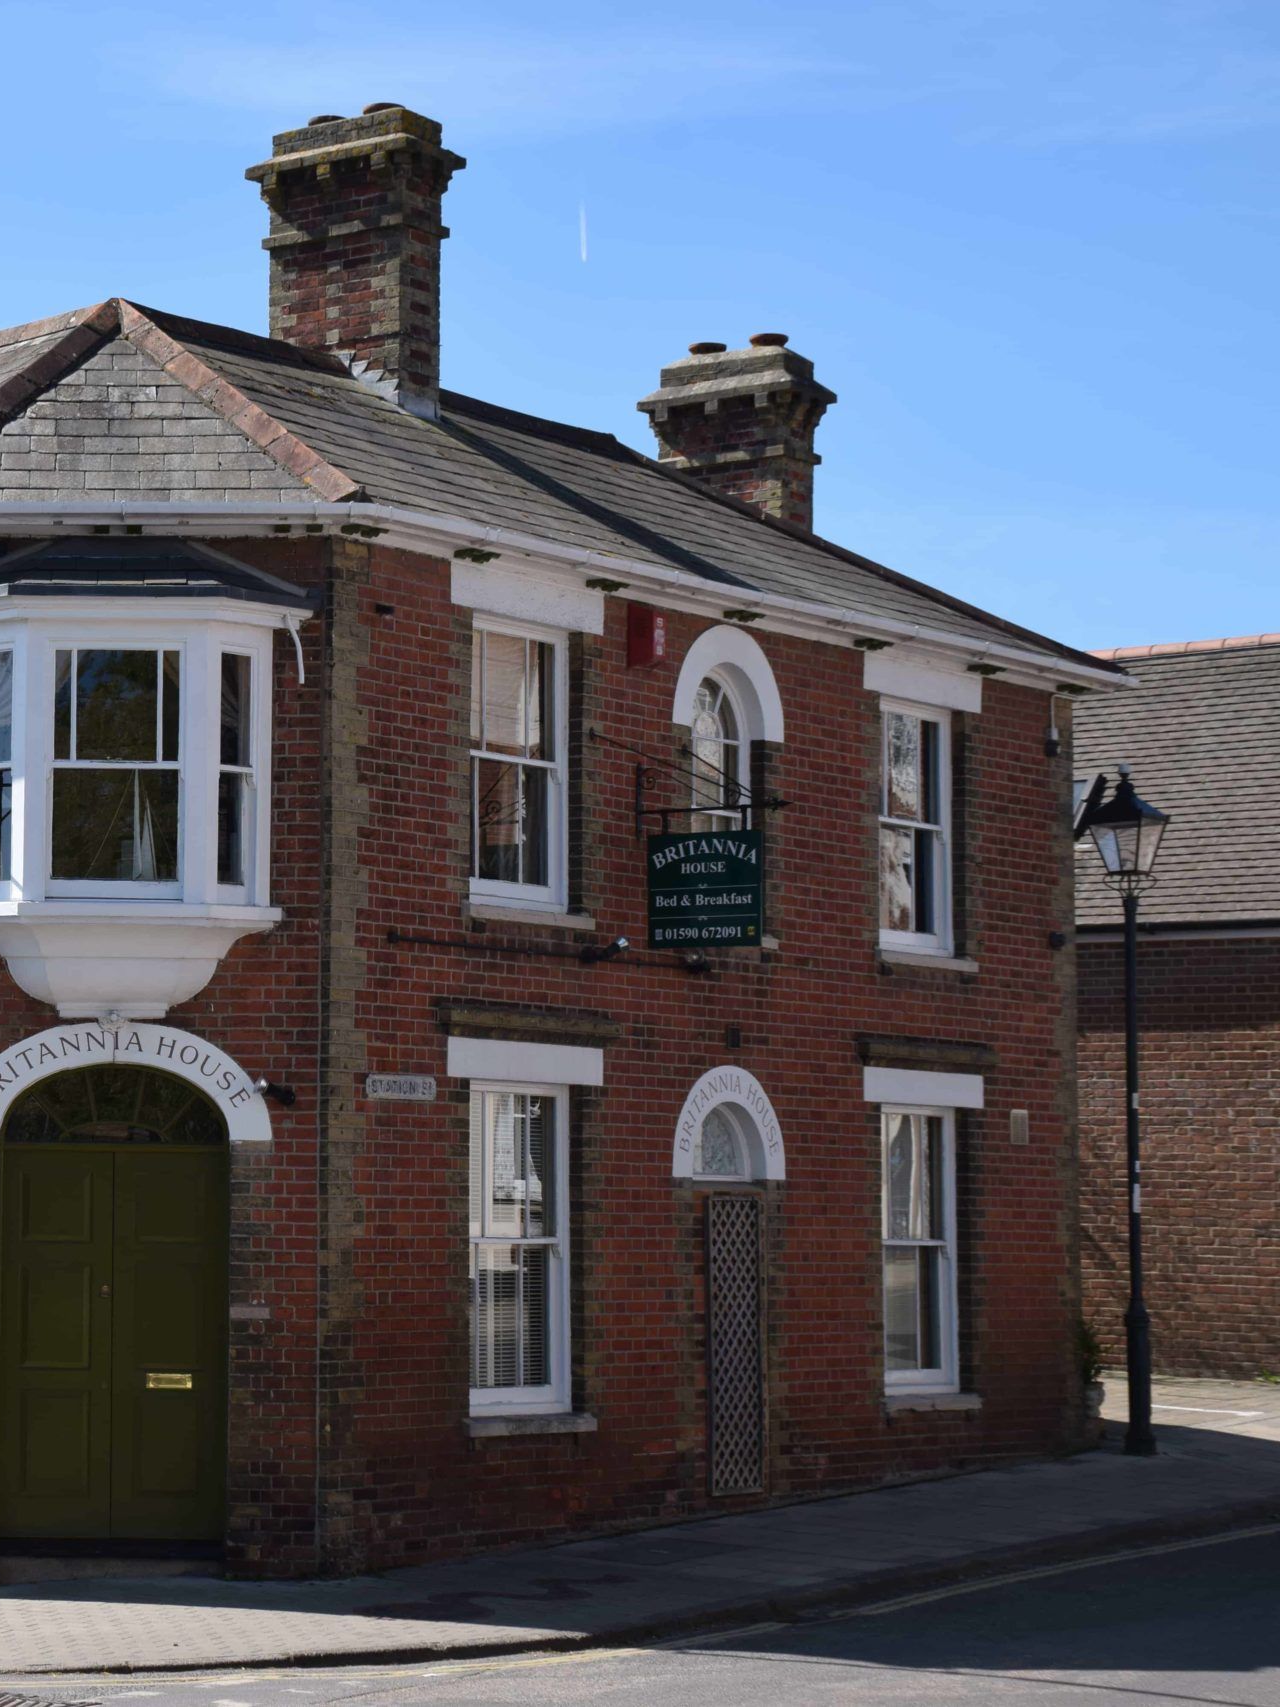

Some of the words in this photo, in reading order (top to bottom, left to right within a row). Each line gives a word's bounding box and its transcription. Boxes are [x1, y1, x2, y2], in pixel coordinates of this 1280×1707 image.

[652, 838, 757, 869] BRITANNIA
[680, 861, 726, 874] HOUSE
[655, 896, 677, 907] Bed
[680, 895, 691, 906] &
[695, 893, 752, 906] Breakfast
[665, 928, 699, 940] 01590
[701, 926, 742, 939] 672091
[156, 1036, 251, 1108] HOUSE
[371, 1080, 416, 1095] STATION
[680, 1074, 742, 1153] BRITANNIA
[746, 1084, 779, 1157] HOUSE
